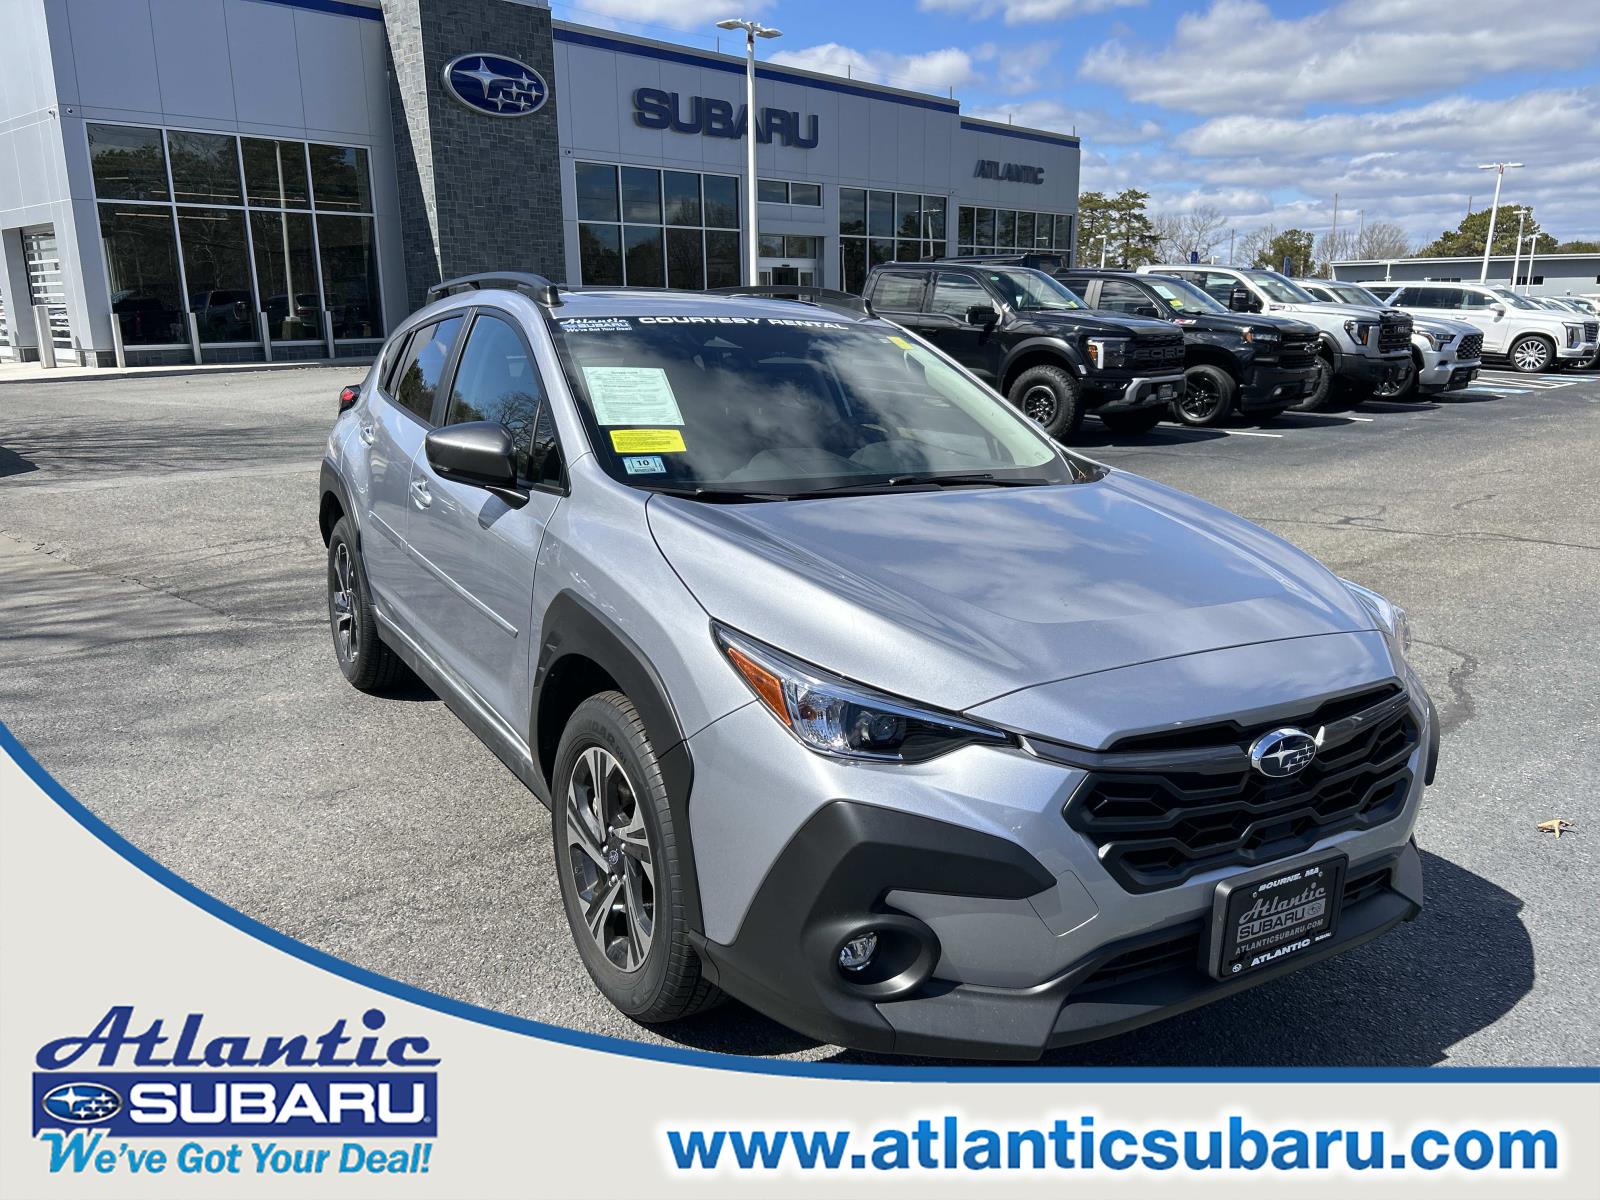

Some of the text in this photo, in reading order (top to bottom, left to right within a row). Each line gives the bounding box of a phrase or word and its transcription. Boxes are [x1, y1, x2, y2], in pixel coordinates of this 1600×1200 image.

[633, 87, 819, 149] SUBARU
[974, 159, 1045, 185] ATLANTIC
[638, 317, 849, 330] COURTESY RENTAL
[636, 459, 650, 467] 10
[1305, 867, 1319, 878] MA
[1239, 882, 1326, 924] Atlantic
[1235, 919, 1324, 955] ATLANTICSUBARU.COM
[1240, 907, 1306, 940] SUBARU
[1251, 938, 1311, 966] ATLANTIC
